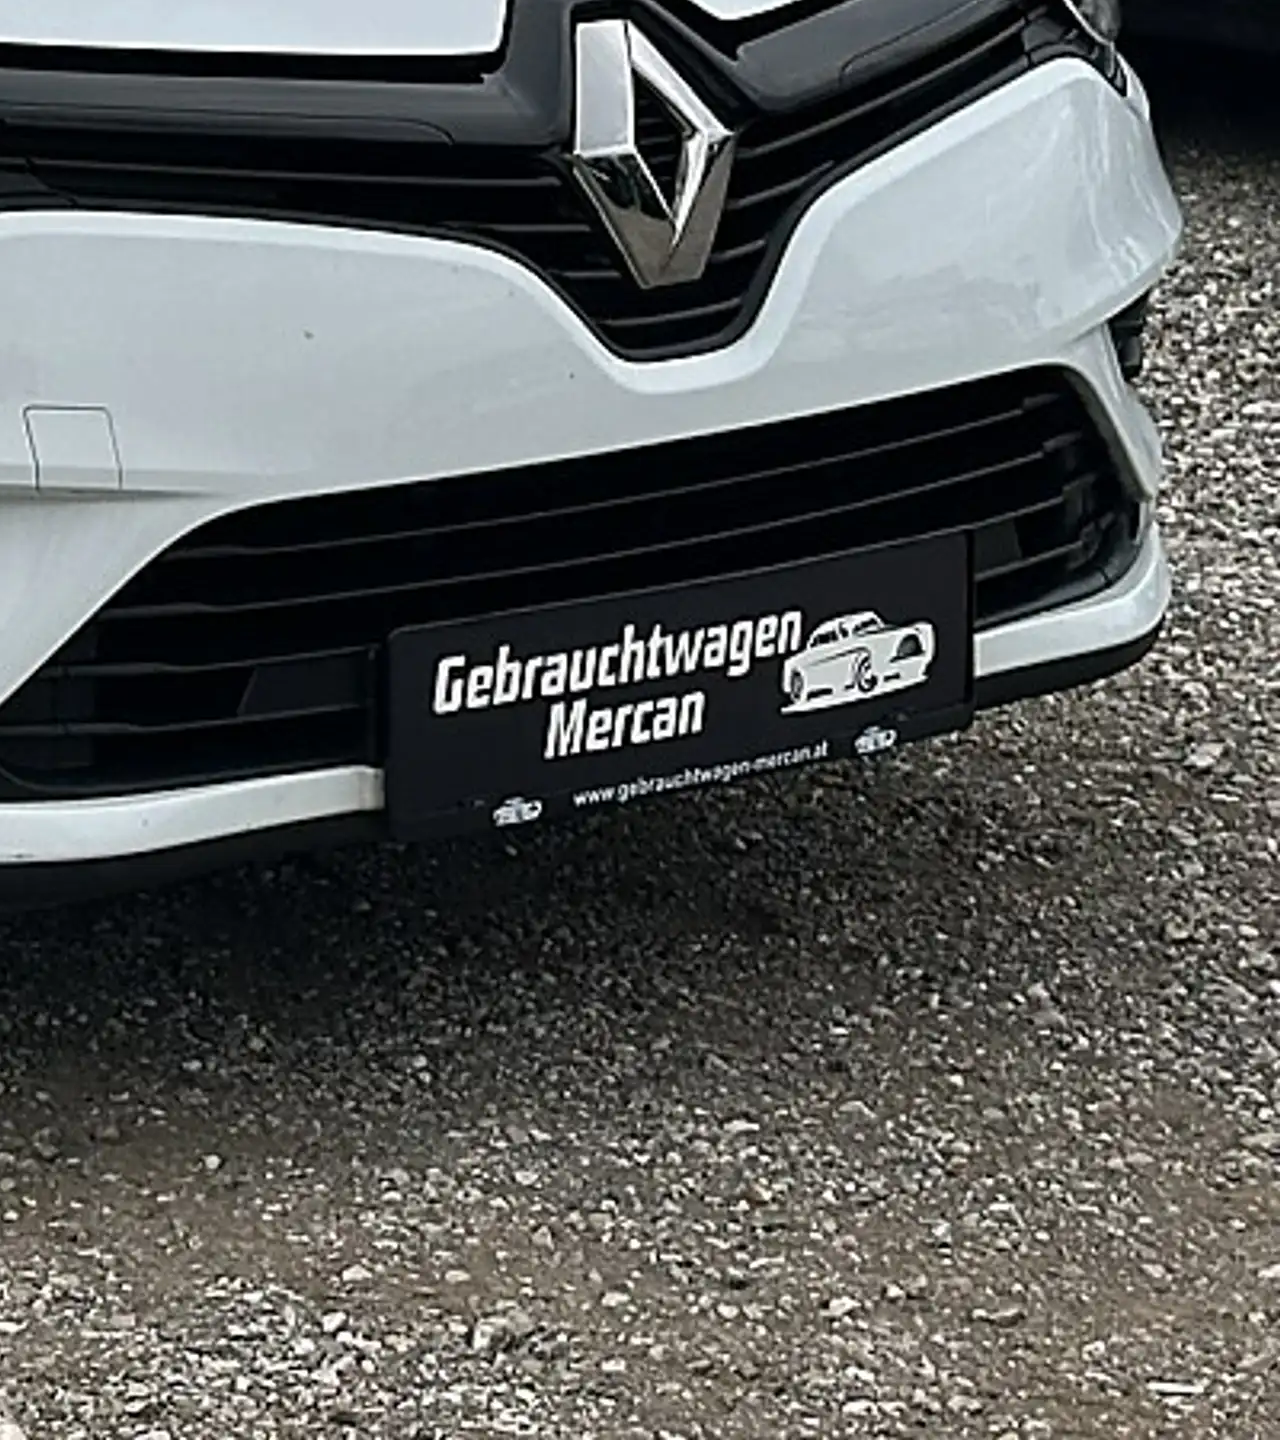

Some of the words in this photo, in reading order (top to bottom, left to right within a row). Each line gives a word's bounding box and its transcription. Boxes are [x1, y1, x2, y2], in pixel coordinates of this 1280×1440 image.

[432, 610, 802, 714] Gebrauchtwagen
[544, 690, 706, 759] Mercan
[573, 740, 829, 807] www.gebrauchtwagen-mercan.at
